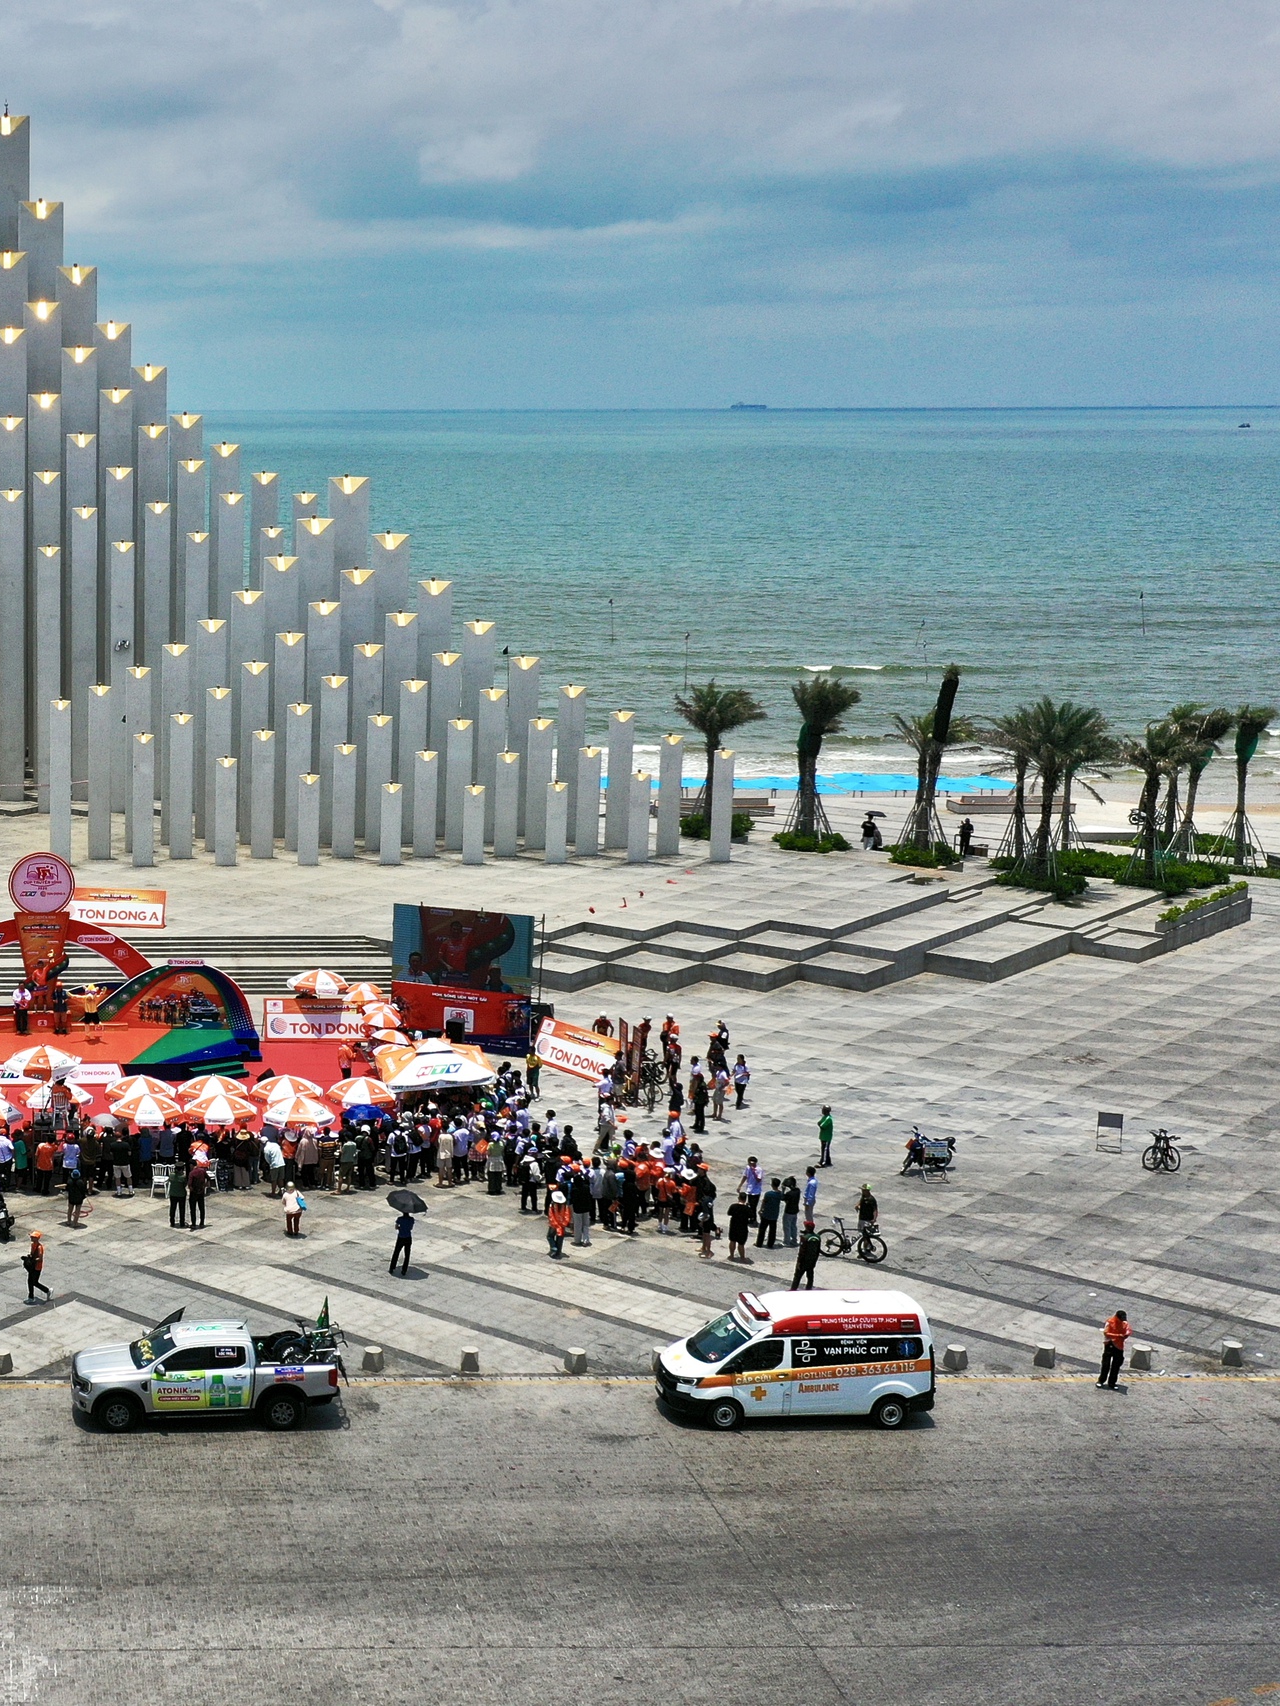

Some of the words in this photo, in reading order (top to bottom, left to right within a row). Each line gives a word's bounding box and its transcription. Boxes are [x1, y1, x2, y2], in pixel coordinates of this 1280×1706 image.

[77, 908, 106, 920] TON
[108, 910, 147, 921] DONG
[149, 911, 159, 921] A
[289, 1023, 322, 1035] TON
[549, 1046, 573, 1064] TON
[572, 1055, 606, 1075] DONG
[418, 1064, 462, 1076] HTV
[823, 1347, 842, 1356] VẠN
[844, 1345, 867, 1355] PHÚC
[870, 1346, 889, 1354] CITY
[797, 1370, 833, 1380] HOTLINE
[883, 1363, 898, 1374] 64
[899, 1362, 915, 1372] 115
[157, 1387, 188, 1395] ATONIK
